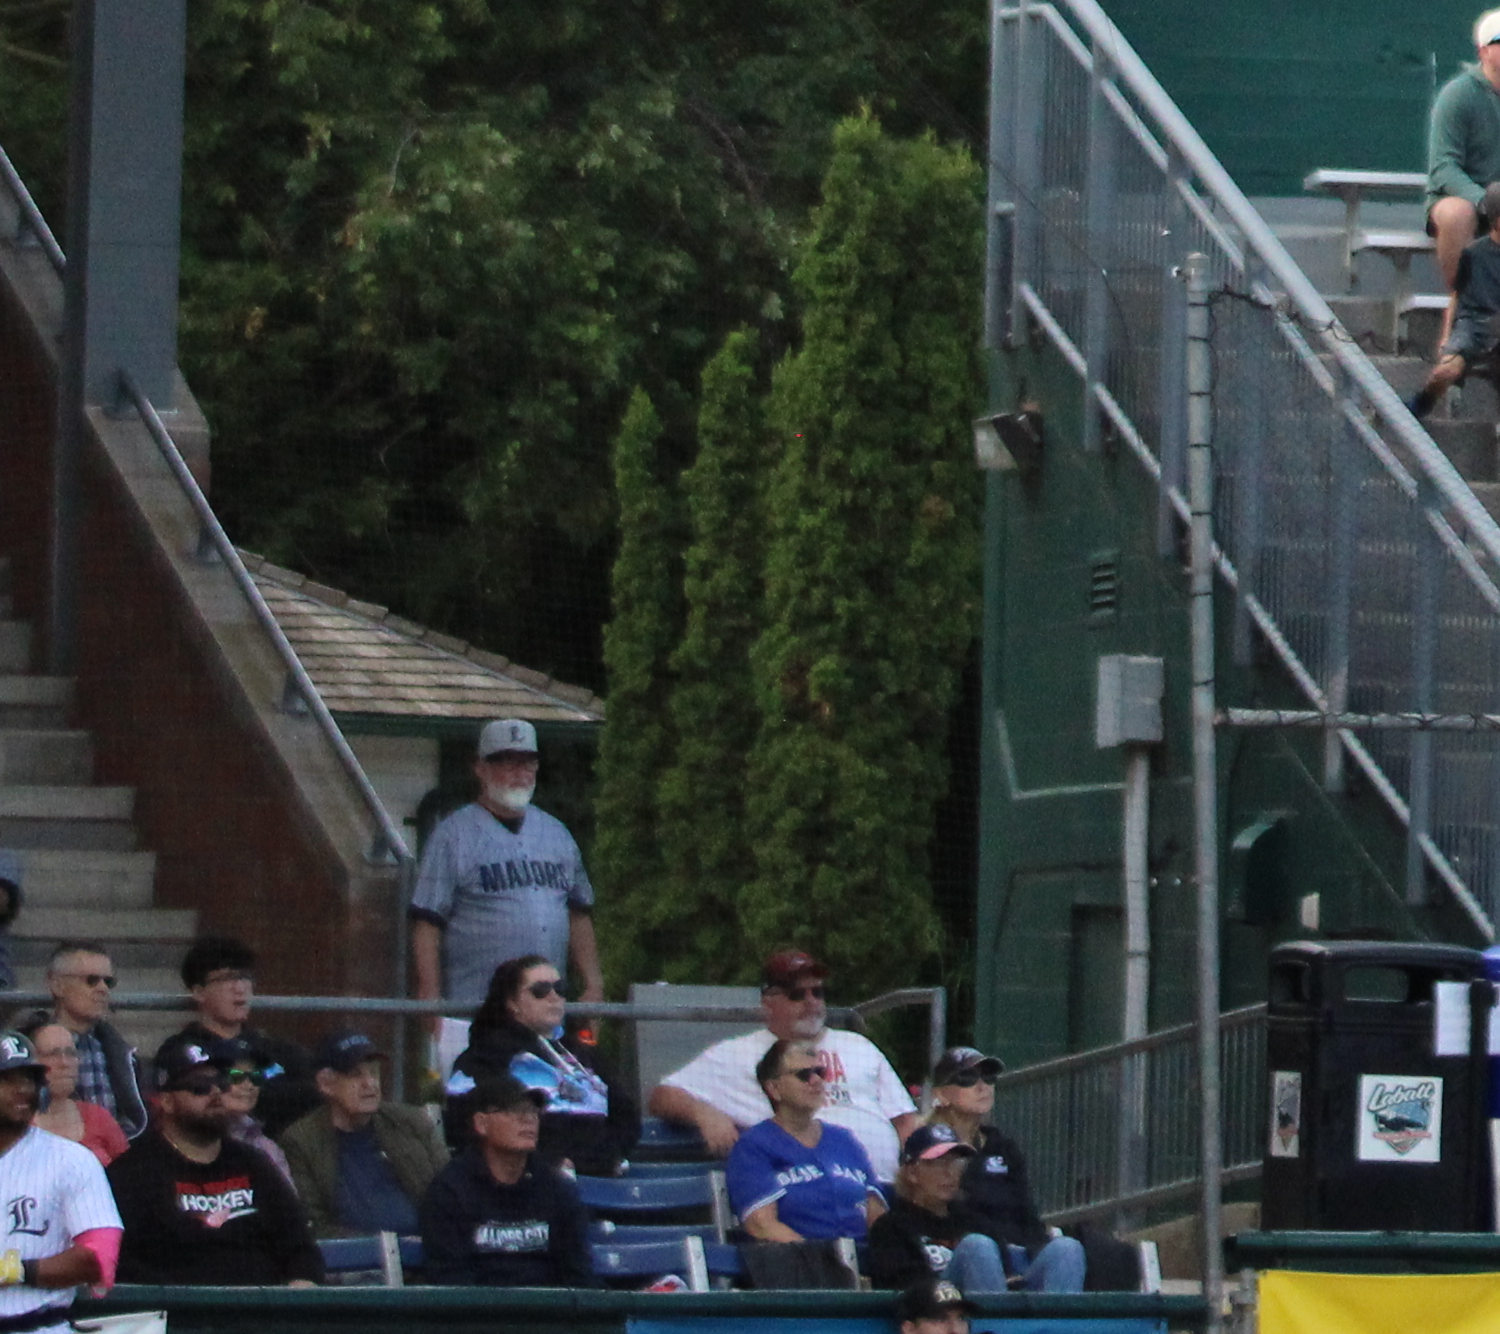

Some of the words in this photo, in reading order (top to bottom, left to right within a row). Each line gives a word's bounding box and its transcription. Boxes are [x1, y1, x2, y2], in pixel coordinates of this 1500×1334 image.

[479, 859, 575, 893] MAJORS
[1367, 1082, 1435, 1113] Labatt
[180, 1188, 255, 1214] HOCKEY
